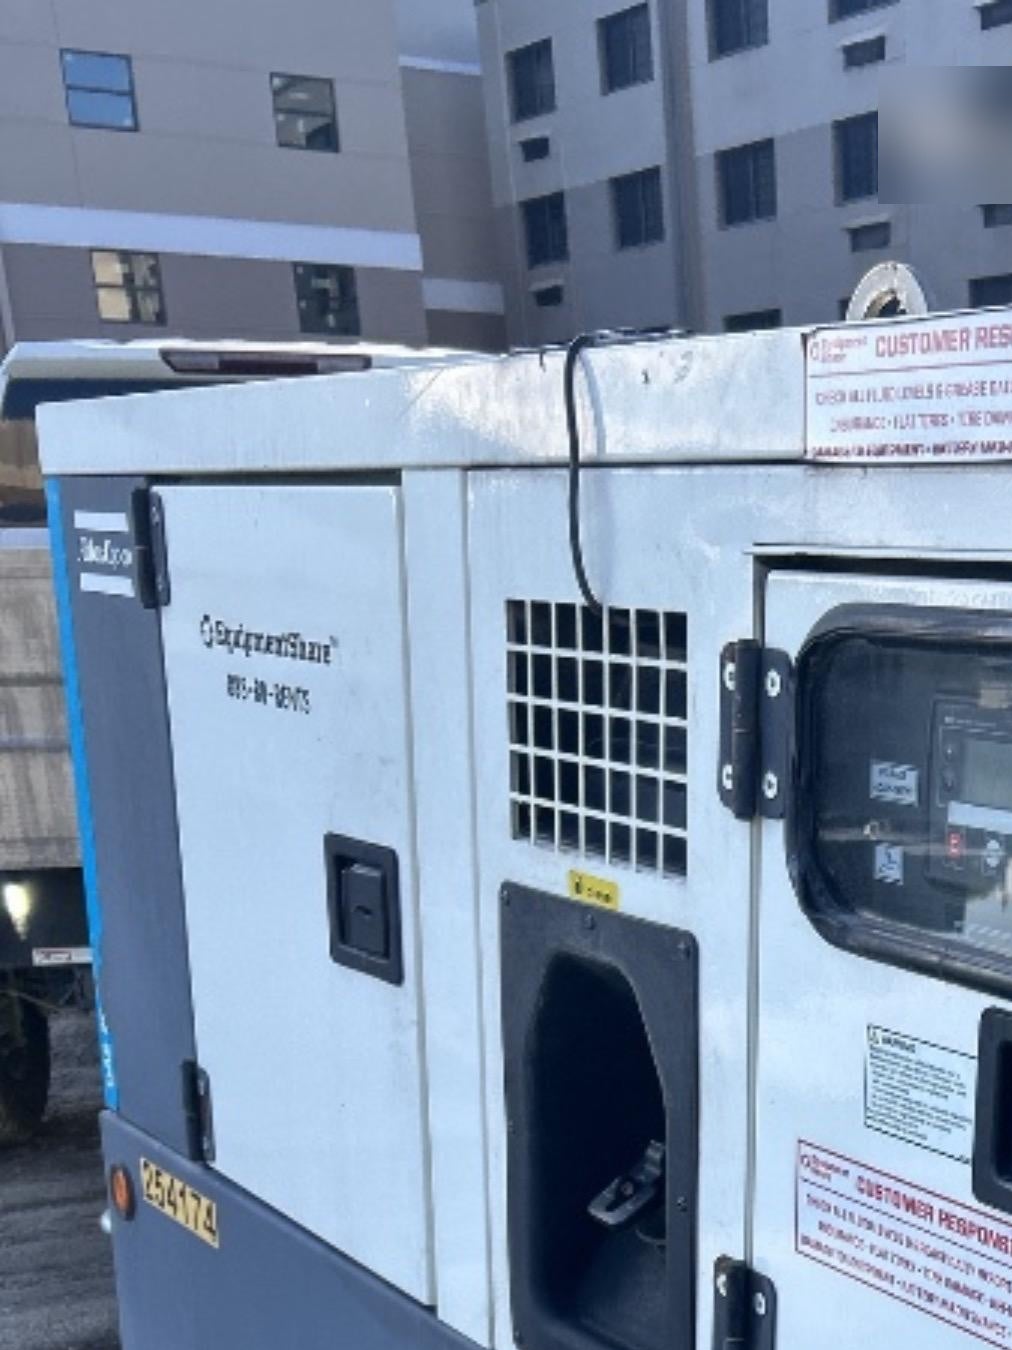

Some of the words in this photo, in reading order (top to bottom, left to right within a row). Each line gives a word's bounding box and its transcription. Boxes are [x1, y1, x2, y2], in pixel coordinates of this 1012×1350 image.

[875, 327, 969, 358] CUSTOMER
[143, 1161, 217, 1243] 254174
[857, 1175, 933, 1224] CUSTOMER
